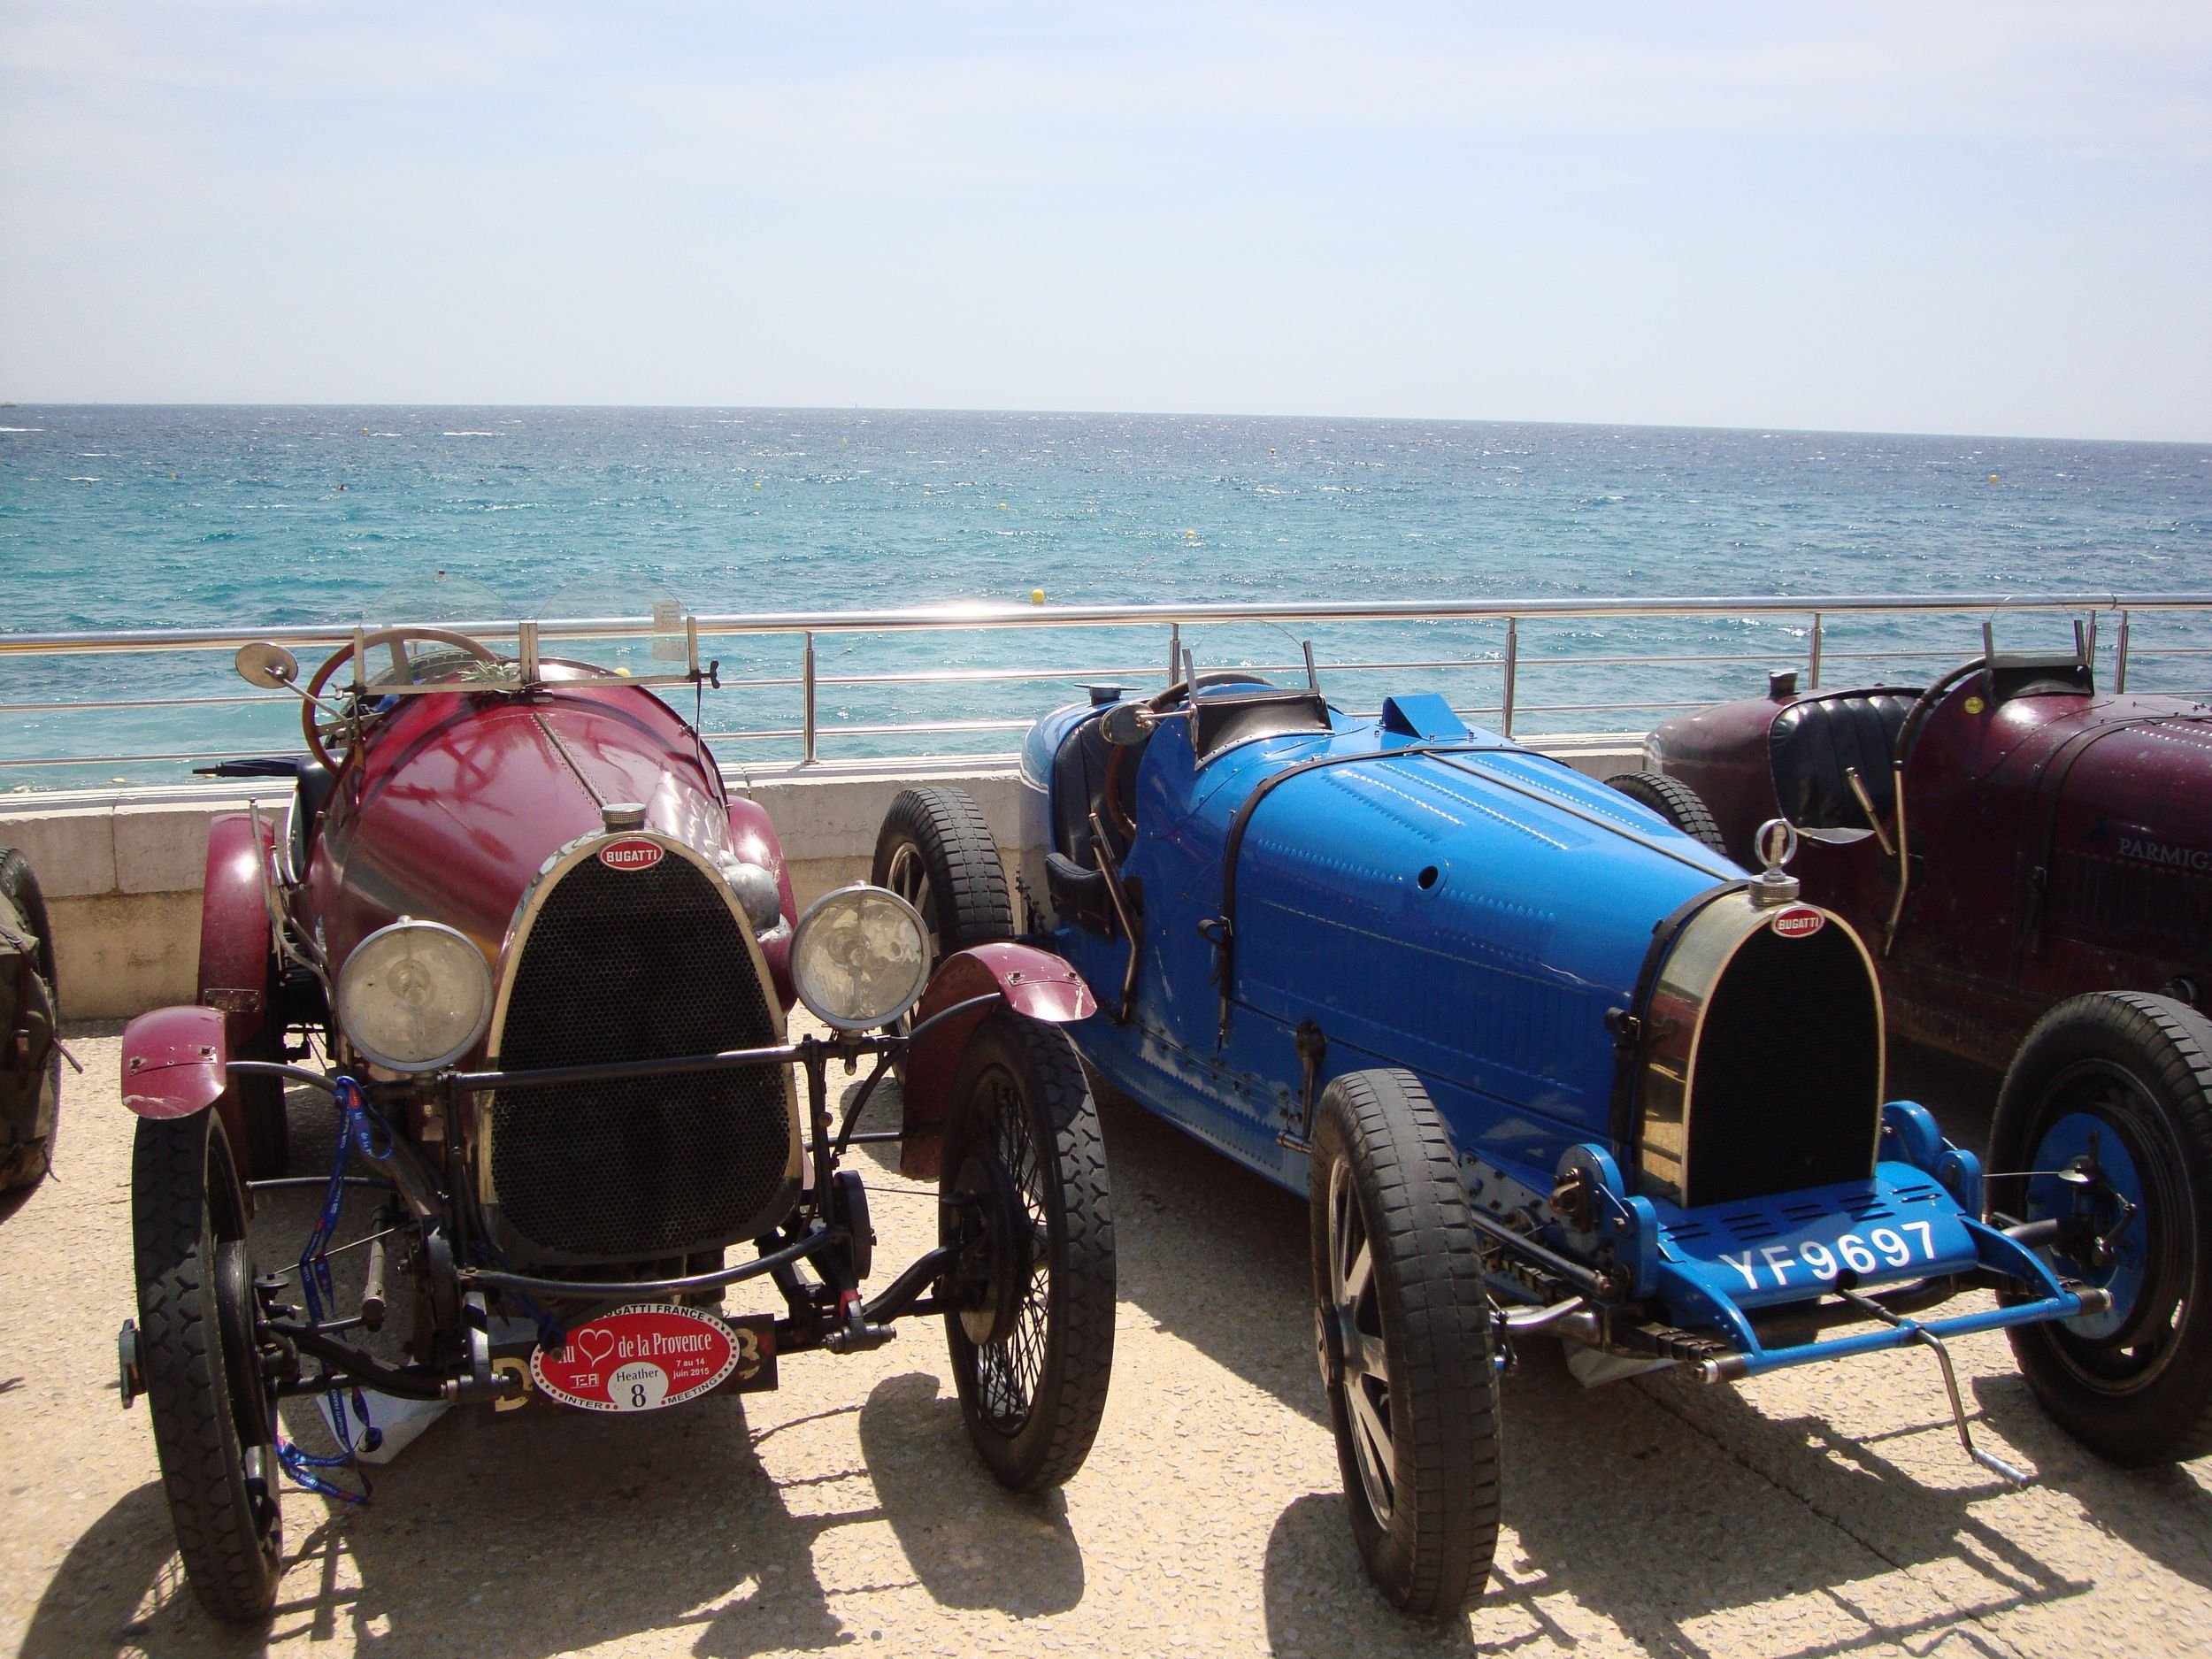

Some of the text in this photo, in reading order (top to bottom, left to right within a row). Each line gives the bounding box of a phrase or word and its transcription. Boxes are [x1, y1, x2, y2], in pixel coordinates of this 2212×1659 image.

[606, 849, 657, 863] BUGATTI
[2117, 836, 2212, 871] PARMIG
[1778, 917, 1819, 930] BUGATTI
[1718, 1221, 1935, 1290] YF9697
[657, 1304, 705, 1320] FRANCE
[618, 1335, 634, 1358] de
[637, 1334, 650, 1356] la
[652, 1333, 712, 1356] Provence
[617, 1368, 659, 1382] Heather
[673, 1367, 710, 1379] juin 2015
[631, 1384, 646, 1408] 8
[667, 1378, 718, 1404] MEETING
[564, 1394, 603, 1409] INTER
